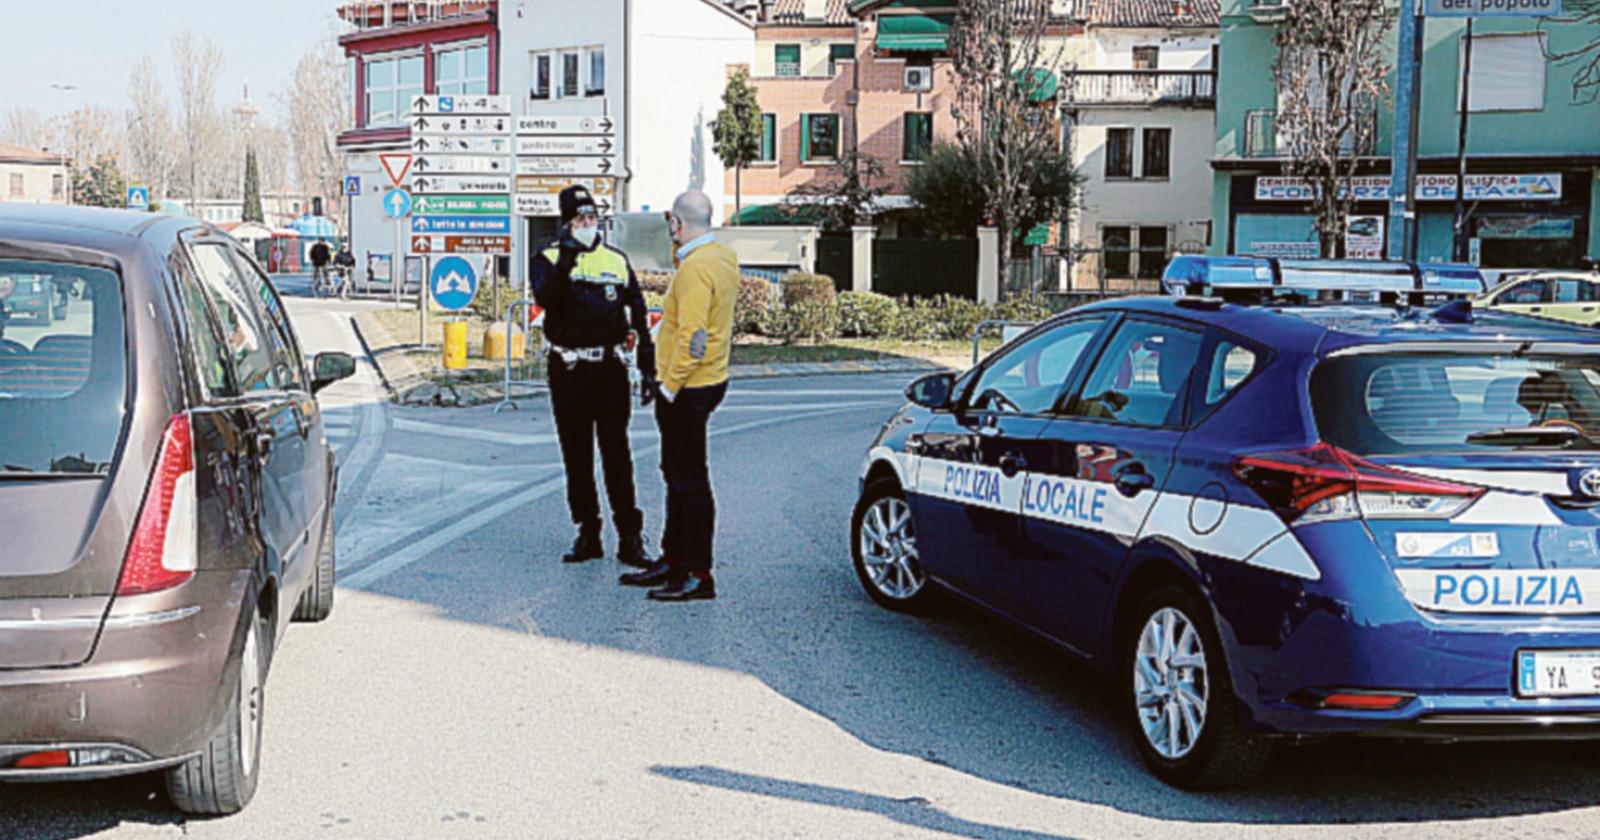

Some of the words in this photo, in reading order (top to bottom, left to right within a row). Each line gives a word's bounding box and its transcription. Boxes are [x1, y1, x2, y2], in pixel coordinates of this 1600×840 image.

[1480, 0, 1551, 12] popolo
[1421, 185, 1504, 198] DETA
[944, 465, 1001, 503] POLIZIA
[1024, 478, 1107, 523] LOCALE
[1434, 575, 1583, 605] POLIZIA
[1546, 665, 1568, 689] YA
